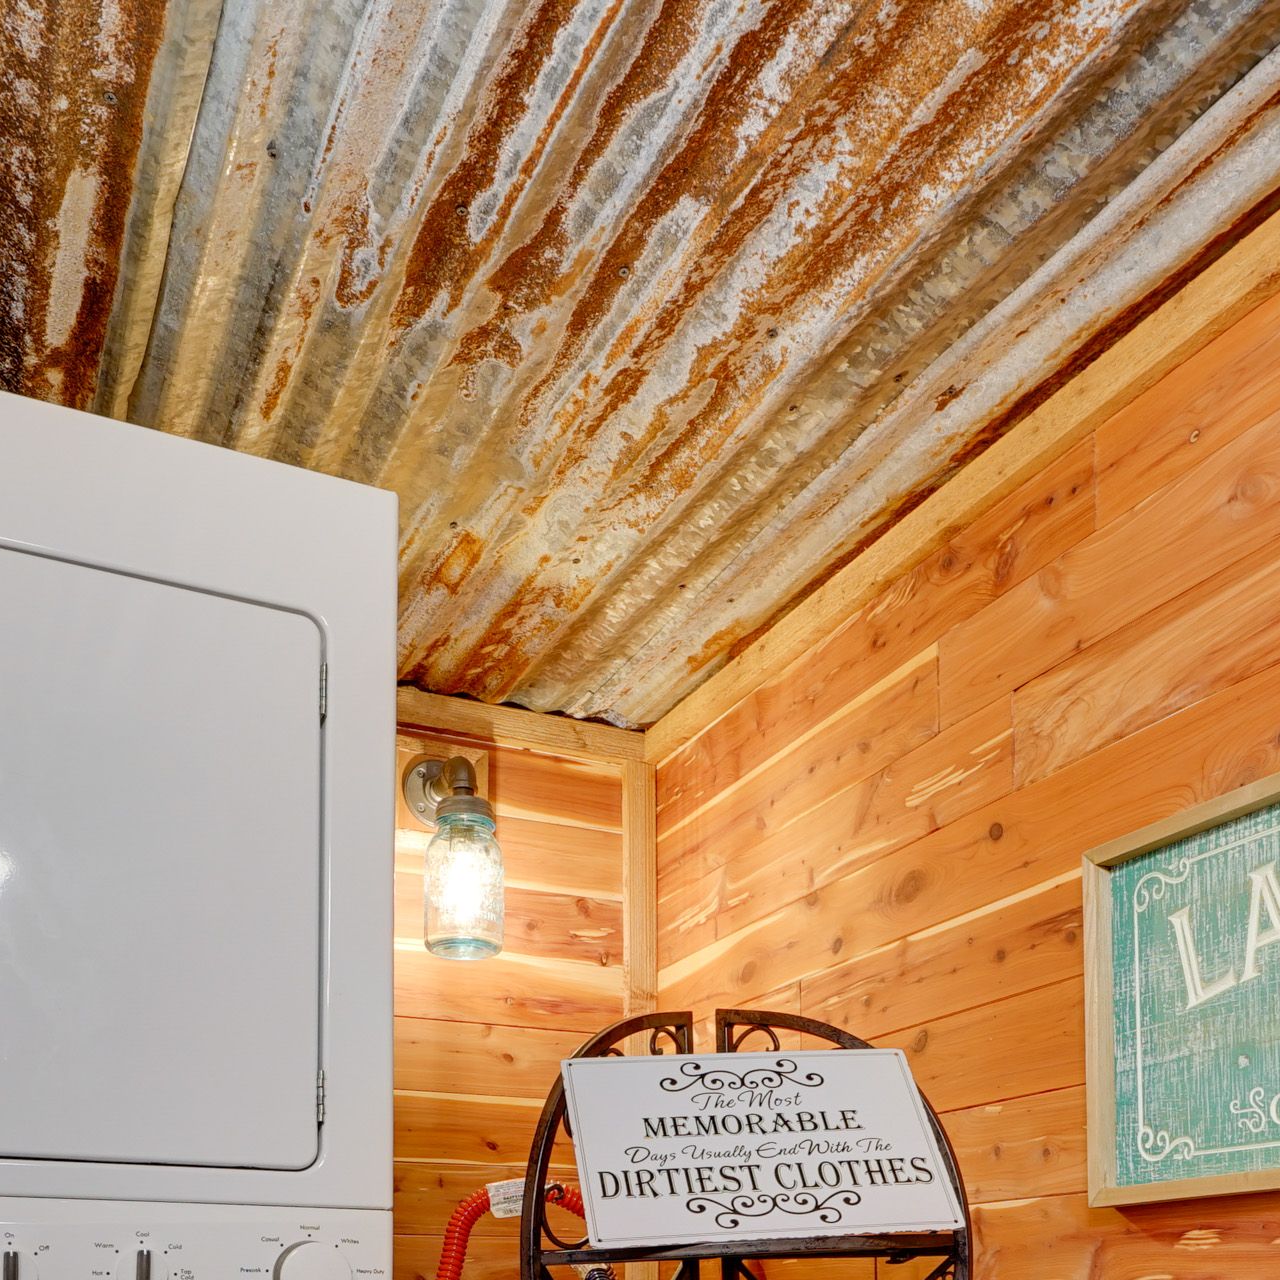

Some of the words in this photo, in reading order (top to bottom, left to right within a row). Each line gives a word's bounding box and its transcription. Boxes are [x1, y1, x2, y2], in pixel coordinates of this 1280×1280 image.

[691, 1092, 736, 1111] The
[737, 1088, 803, 1111] Most
[643, 1109, 863, 1139] MEMORABLE
[625, 1145, 677, 1167] Days
[682, 1140, 752, 1164] Usually
[756, 1141, 800, 1159] End
[799, 1138, 853, 1157] With
[856, 1137, 893, 1153] The
[597, 1164, 761, 1200] DIRTIEST
[774, 1156, 934, 1190] CLOTHES
